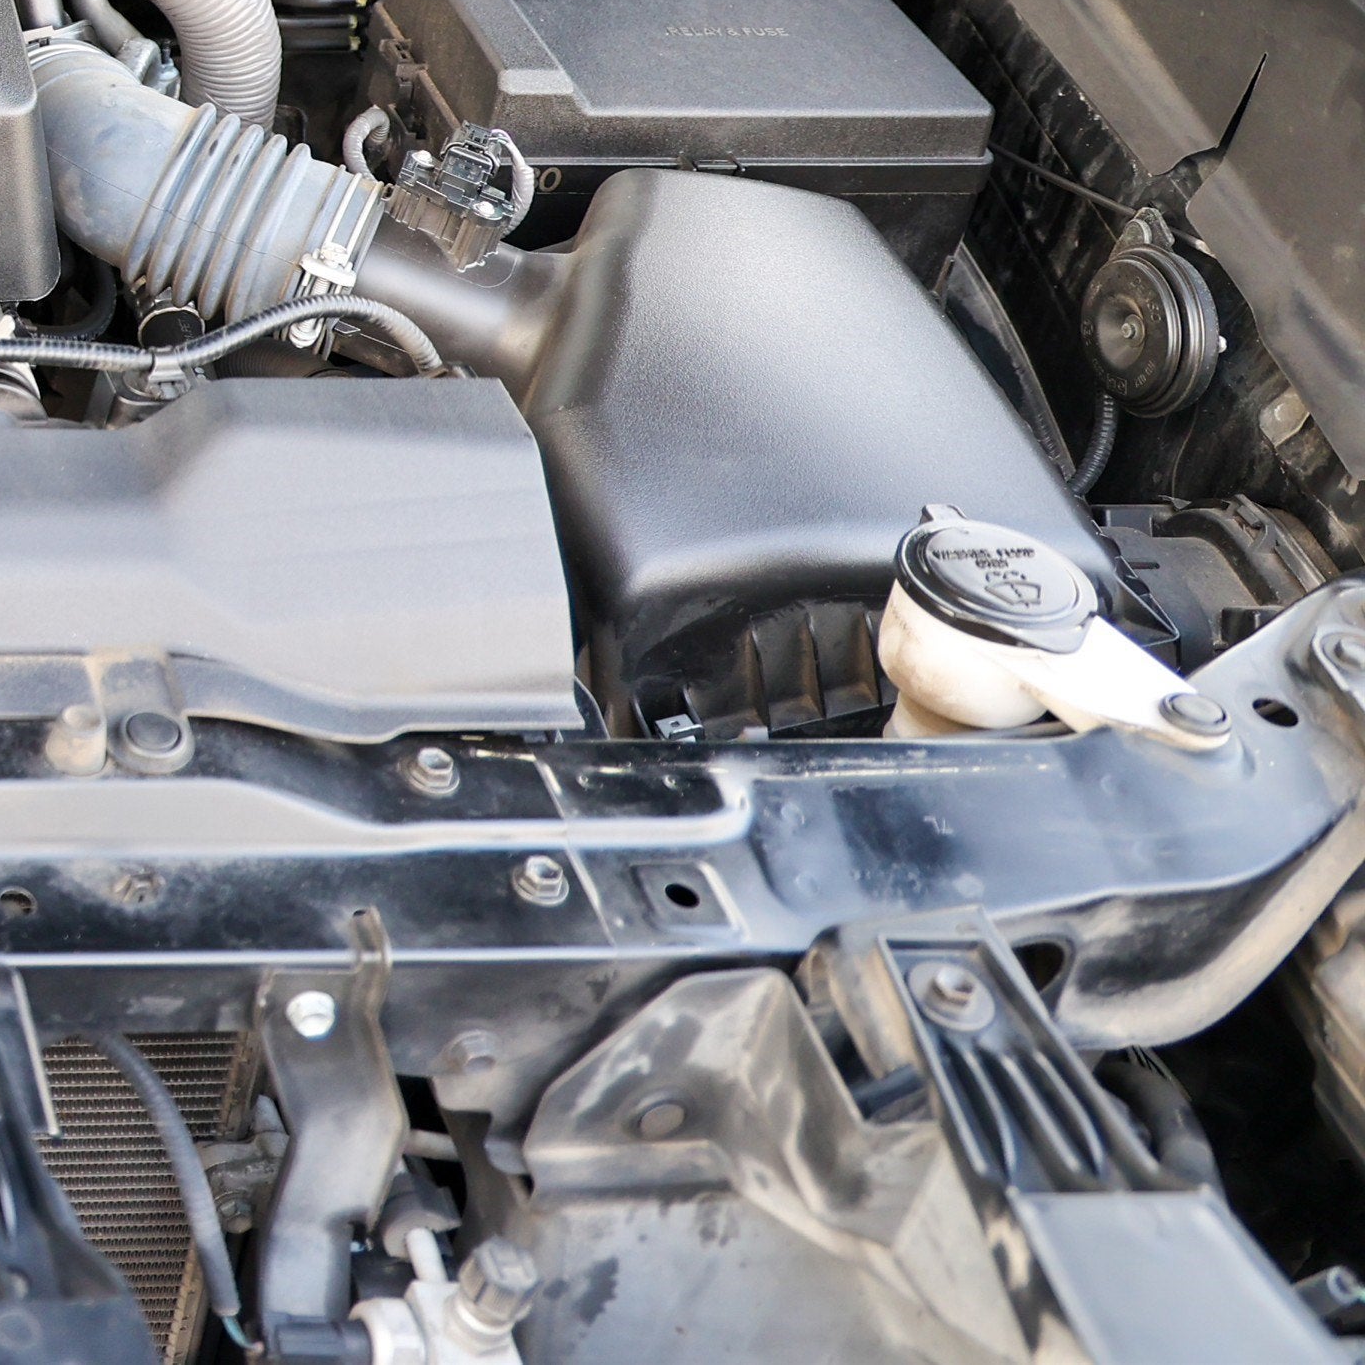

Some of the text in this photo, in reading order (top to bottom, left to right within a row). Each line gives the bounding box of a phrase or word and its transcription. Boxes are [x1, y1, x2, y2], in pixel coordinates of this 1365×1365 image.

[666, 26, 790, 37] RELAY & FUSE
